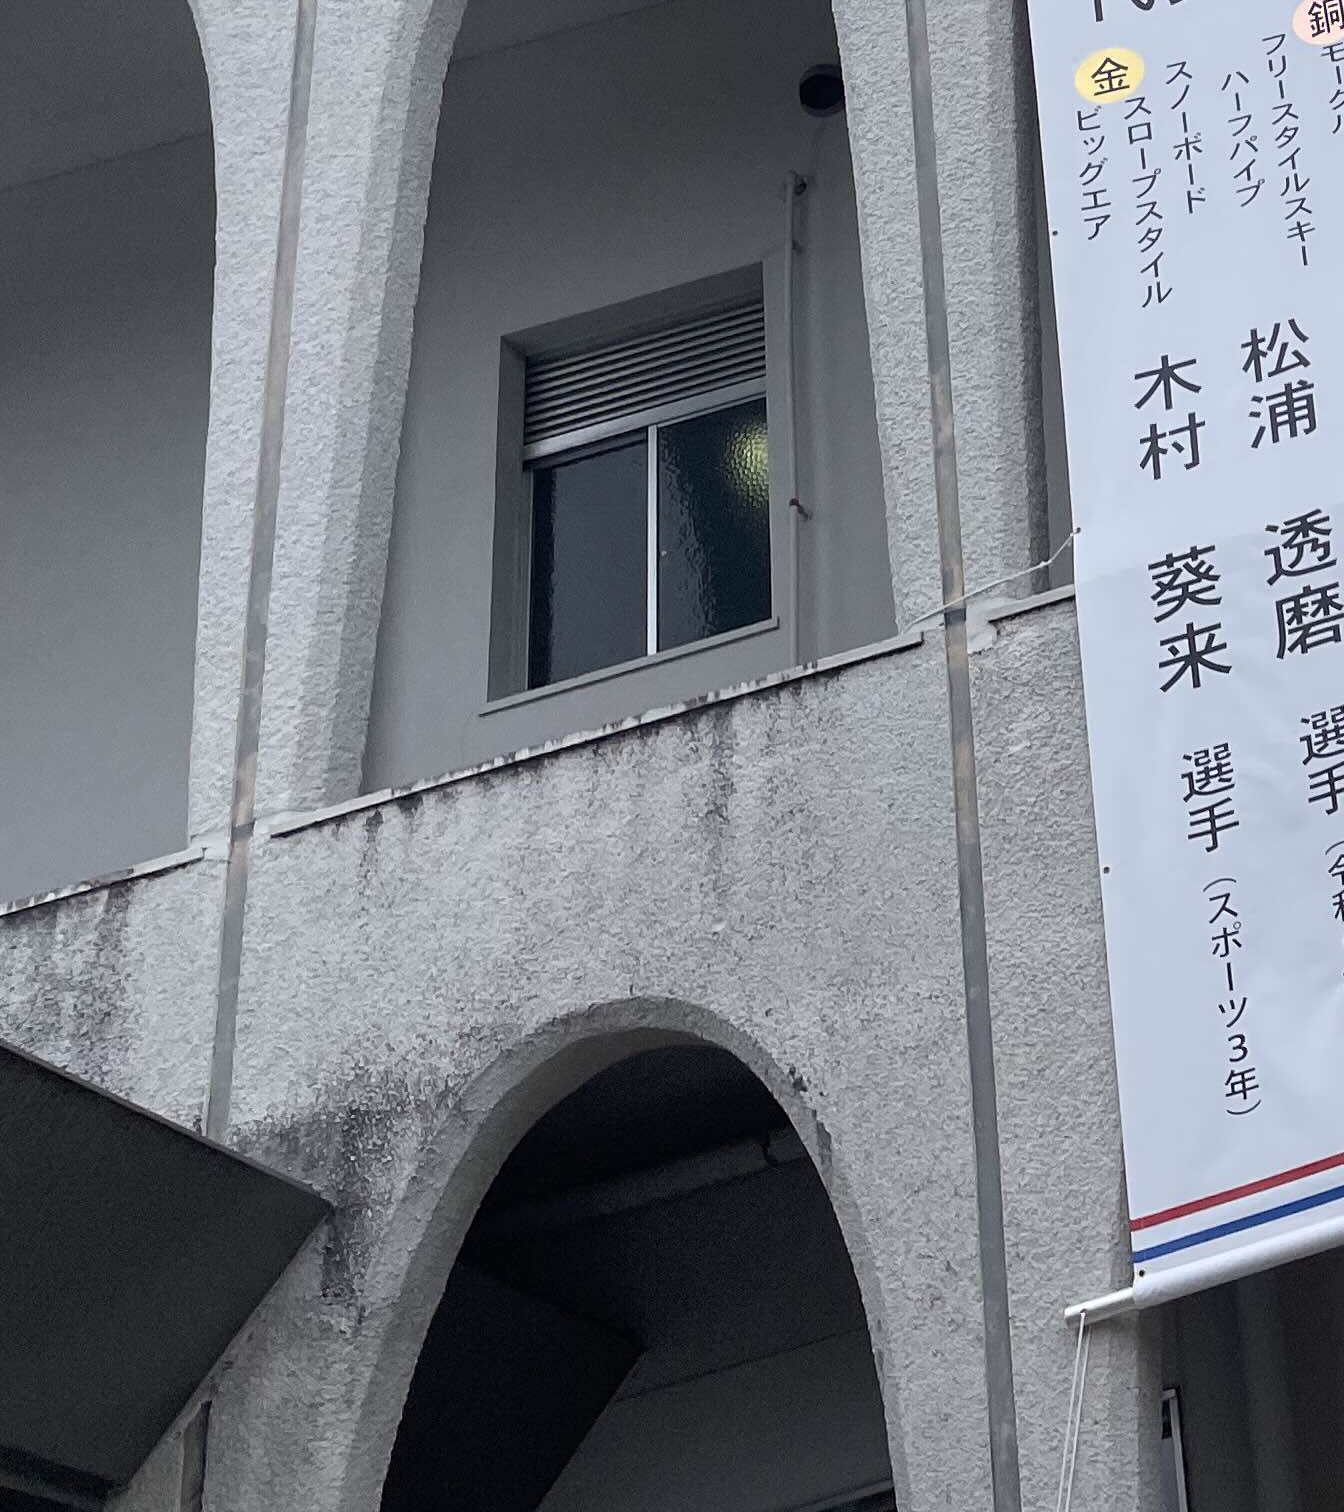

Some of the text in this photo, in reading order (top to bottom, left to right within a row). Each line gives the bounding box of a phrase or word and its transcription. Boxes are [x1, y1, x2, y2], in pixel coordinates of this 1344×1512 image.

[1077, 57, 1130, 240] 金 ビッグエア
[1124, 97, 1173, 308] スロープスタイル
[1166, 61, 1206, 214] スノーボード
[1221, 71, 1265, 207] ハーフパイプ
[1262, 34, 1315, 266] フリースタイルスキー
[1134, 355, 1205, 480] 木村
[1241, 318, 1316, 448] 松浦
[1148, 545, 1232, 692] 葵来
[1264, 509, 1344, 660] 透磨
[1181, 743, 1239, 852] 選手
